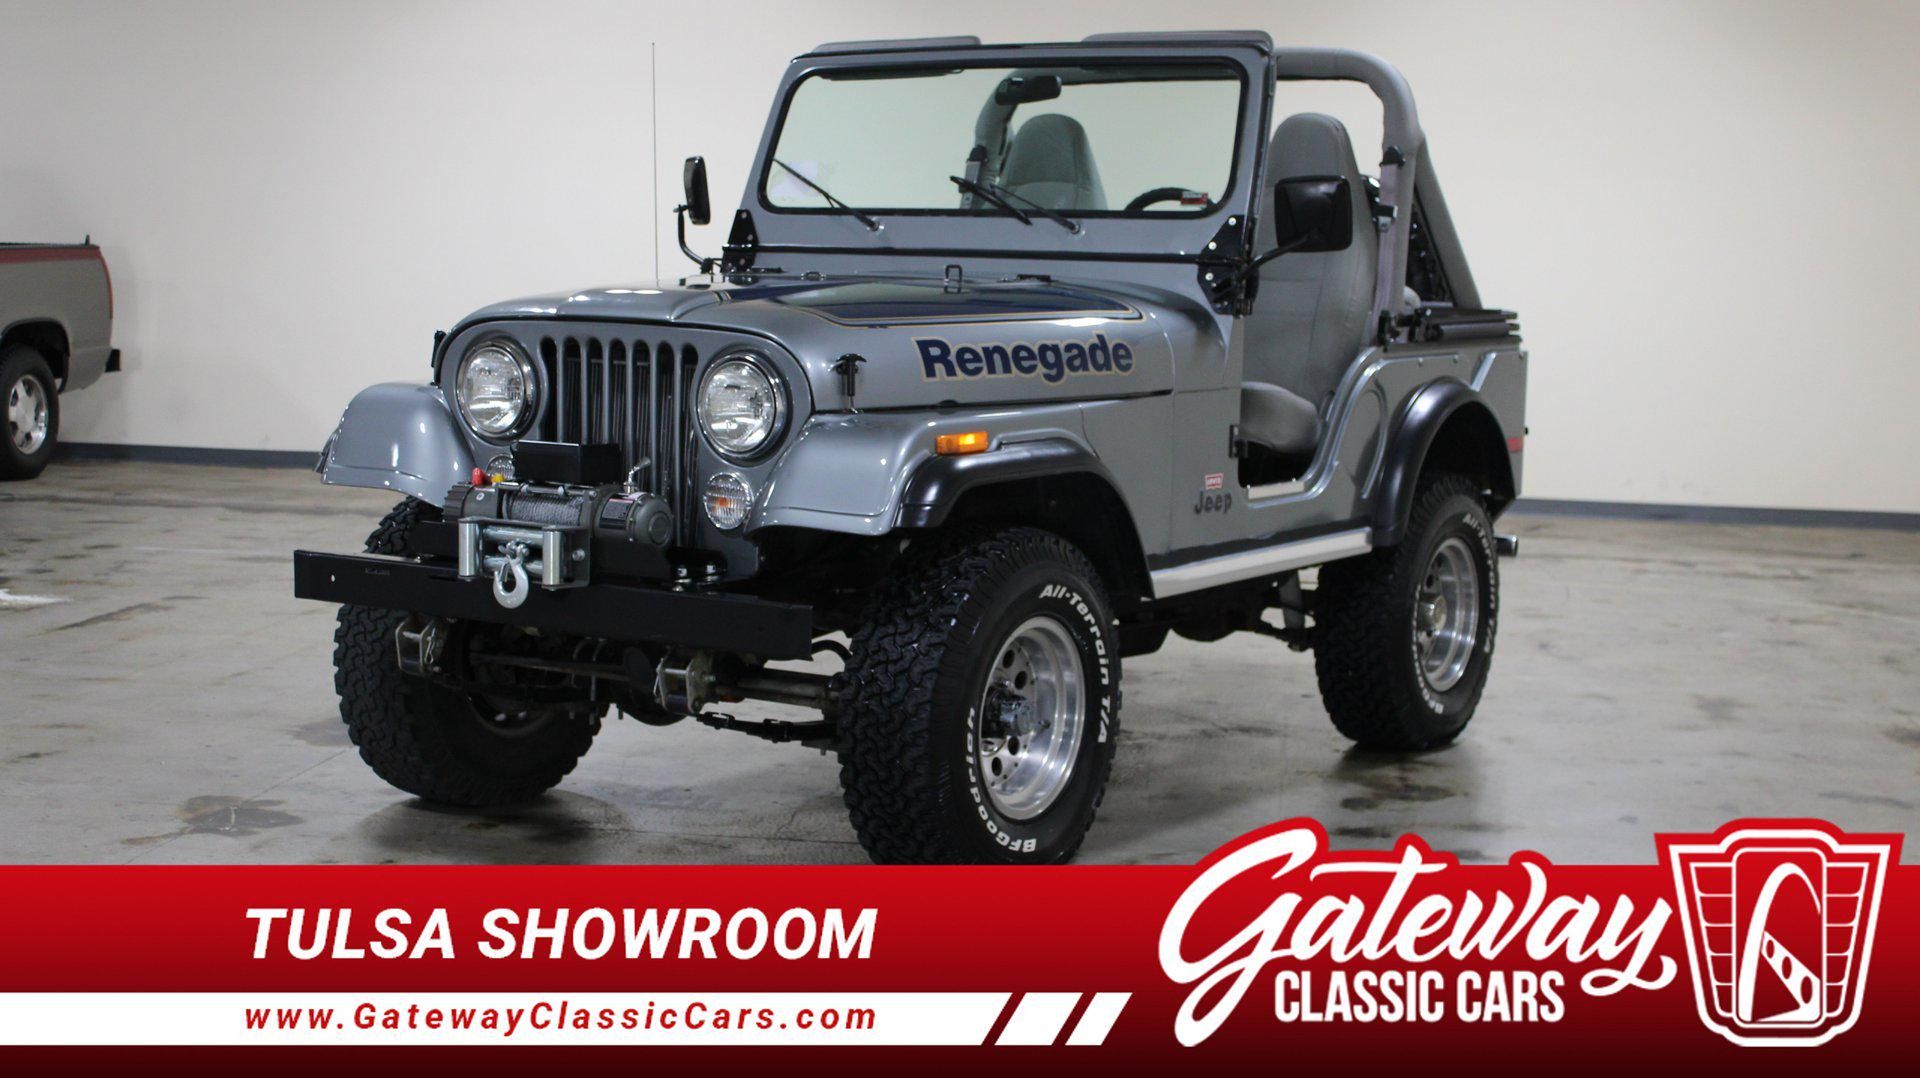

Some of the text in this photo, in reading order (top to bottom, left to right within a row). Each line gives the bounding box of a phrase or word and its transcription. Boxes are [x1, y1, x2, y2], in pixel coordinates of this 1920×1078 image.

[914, 332, 1134, 384] Renegade
[1194, 490, 1232, 515] Jeep
[1039, 584, 1111, 743] All-Terrain T/A
[966, 706, 1038, 853] BFGoodrich
